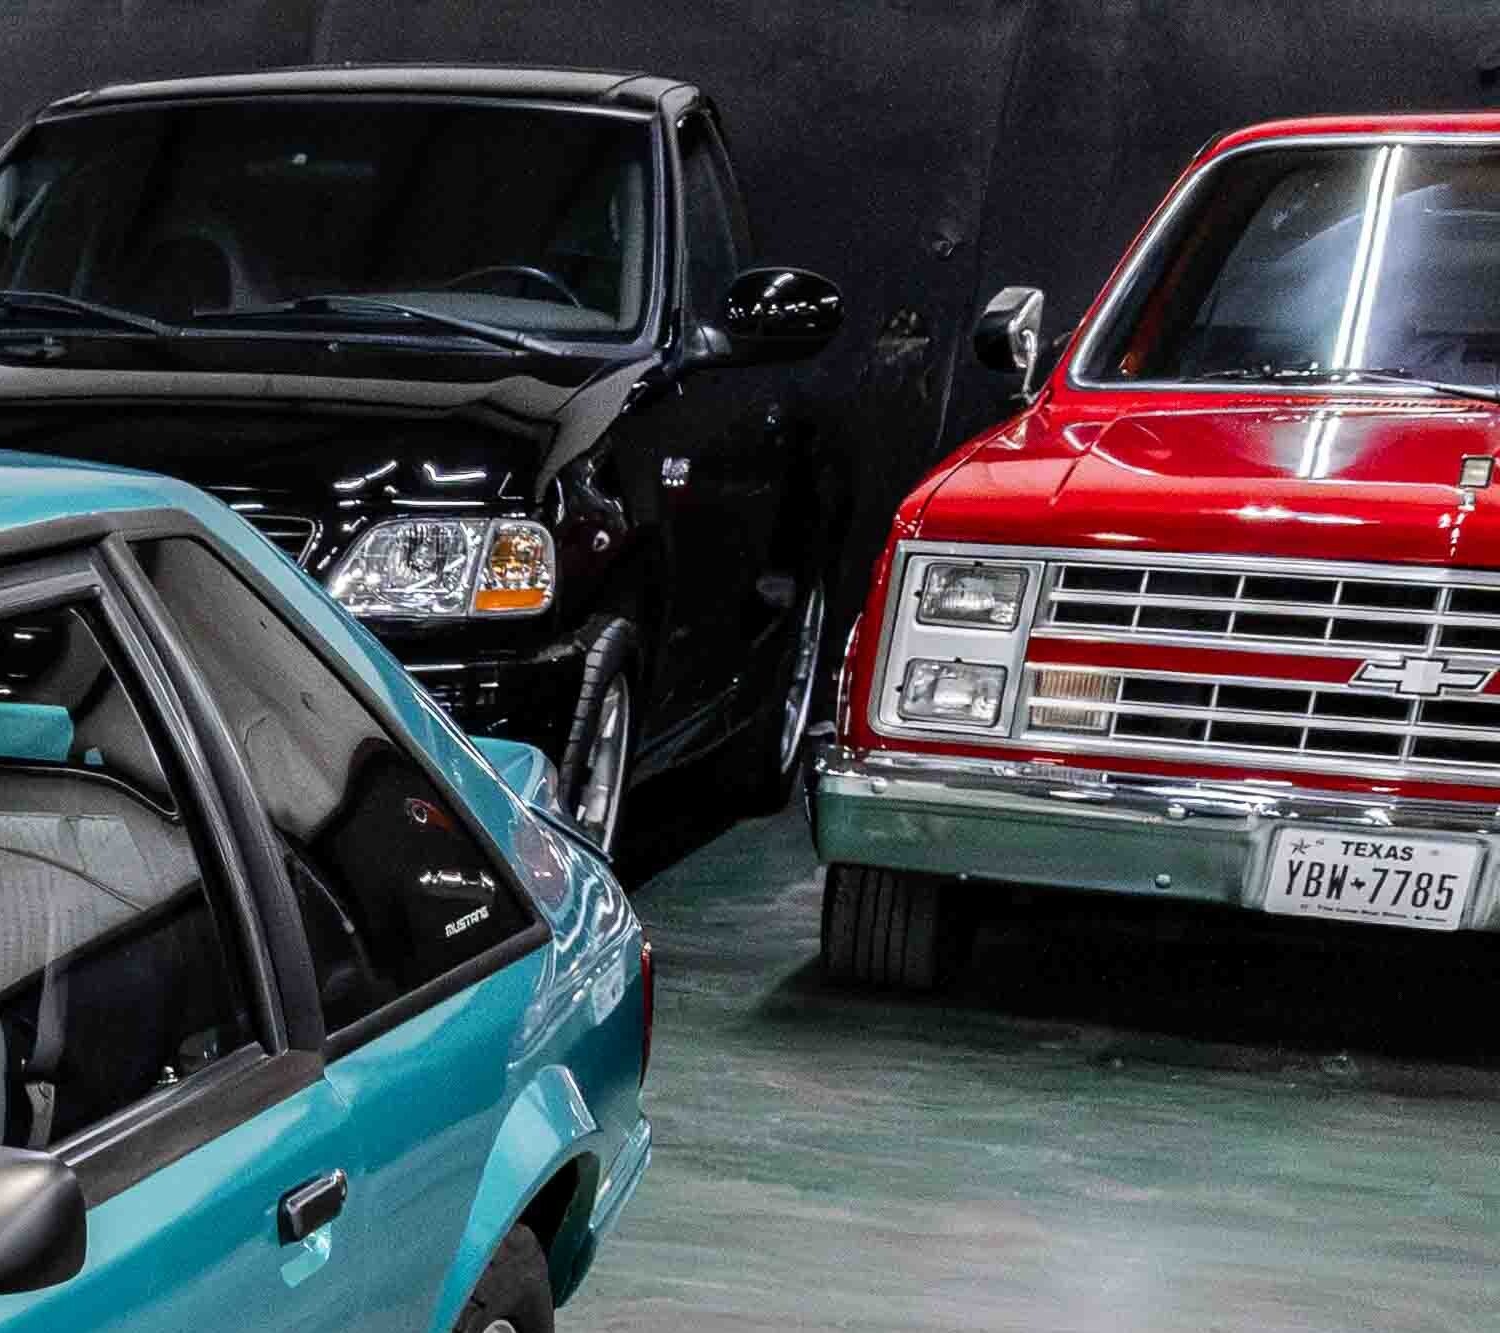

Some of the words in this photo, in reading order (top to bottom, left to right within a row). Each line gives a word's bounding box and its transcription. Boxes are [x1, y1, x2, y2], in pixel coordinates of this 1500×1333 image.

[1341, 840, 1415, 862] TEXAS
[1284, 859, 1349, 900] YBW
[1368, 867, 1459, 911] 7785
[445, 905, 490, 938] MUSTANG
